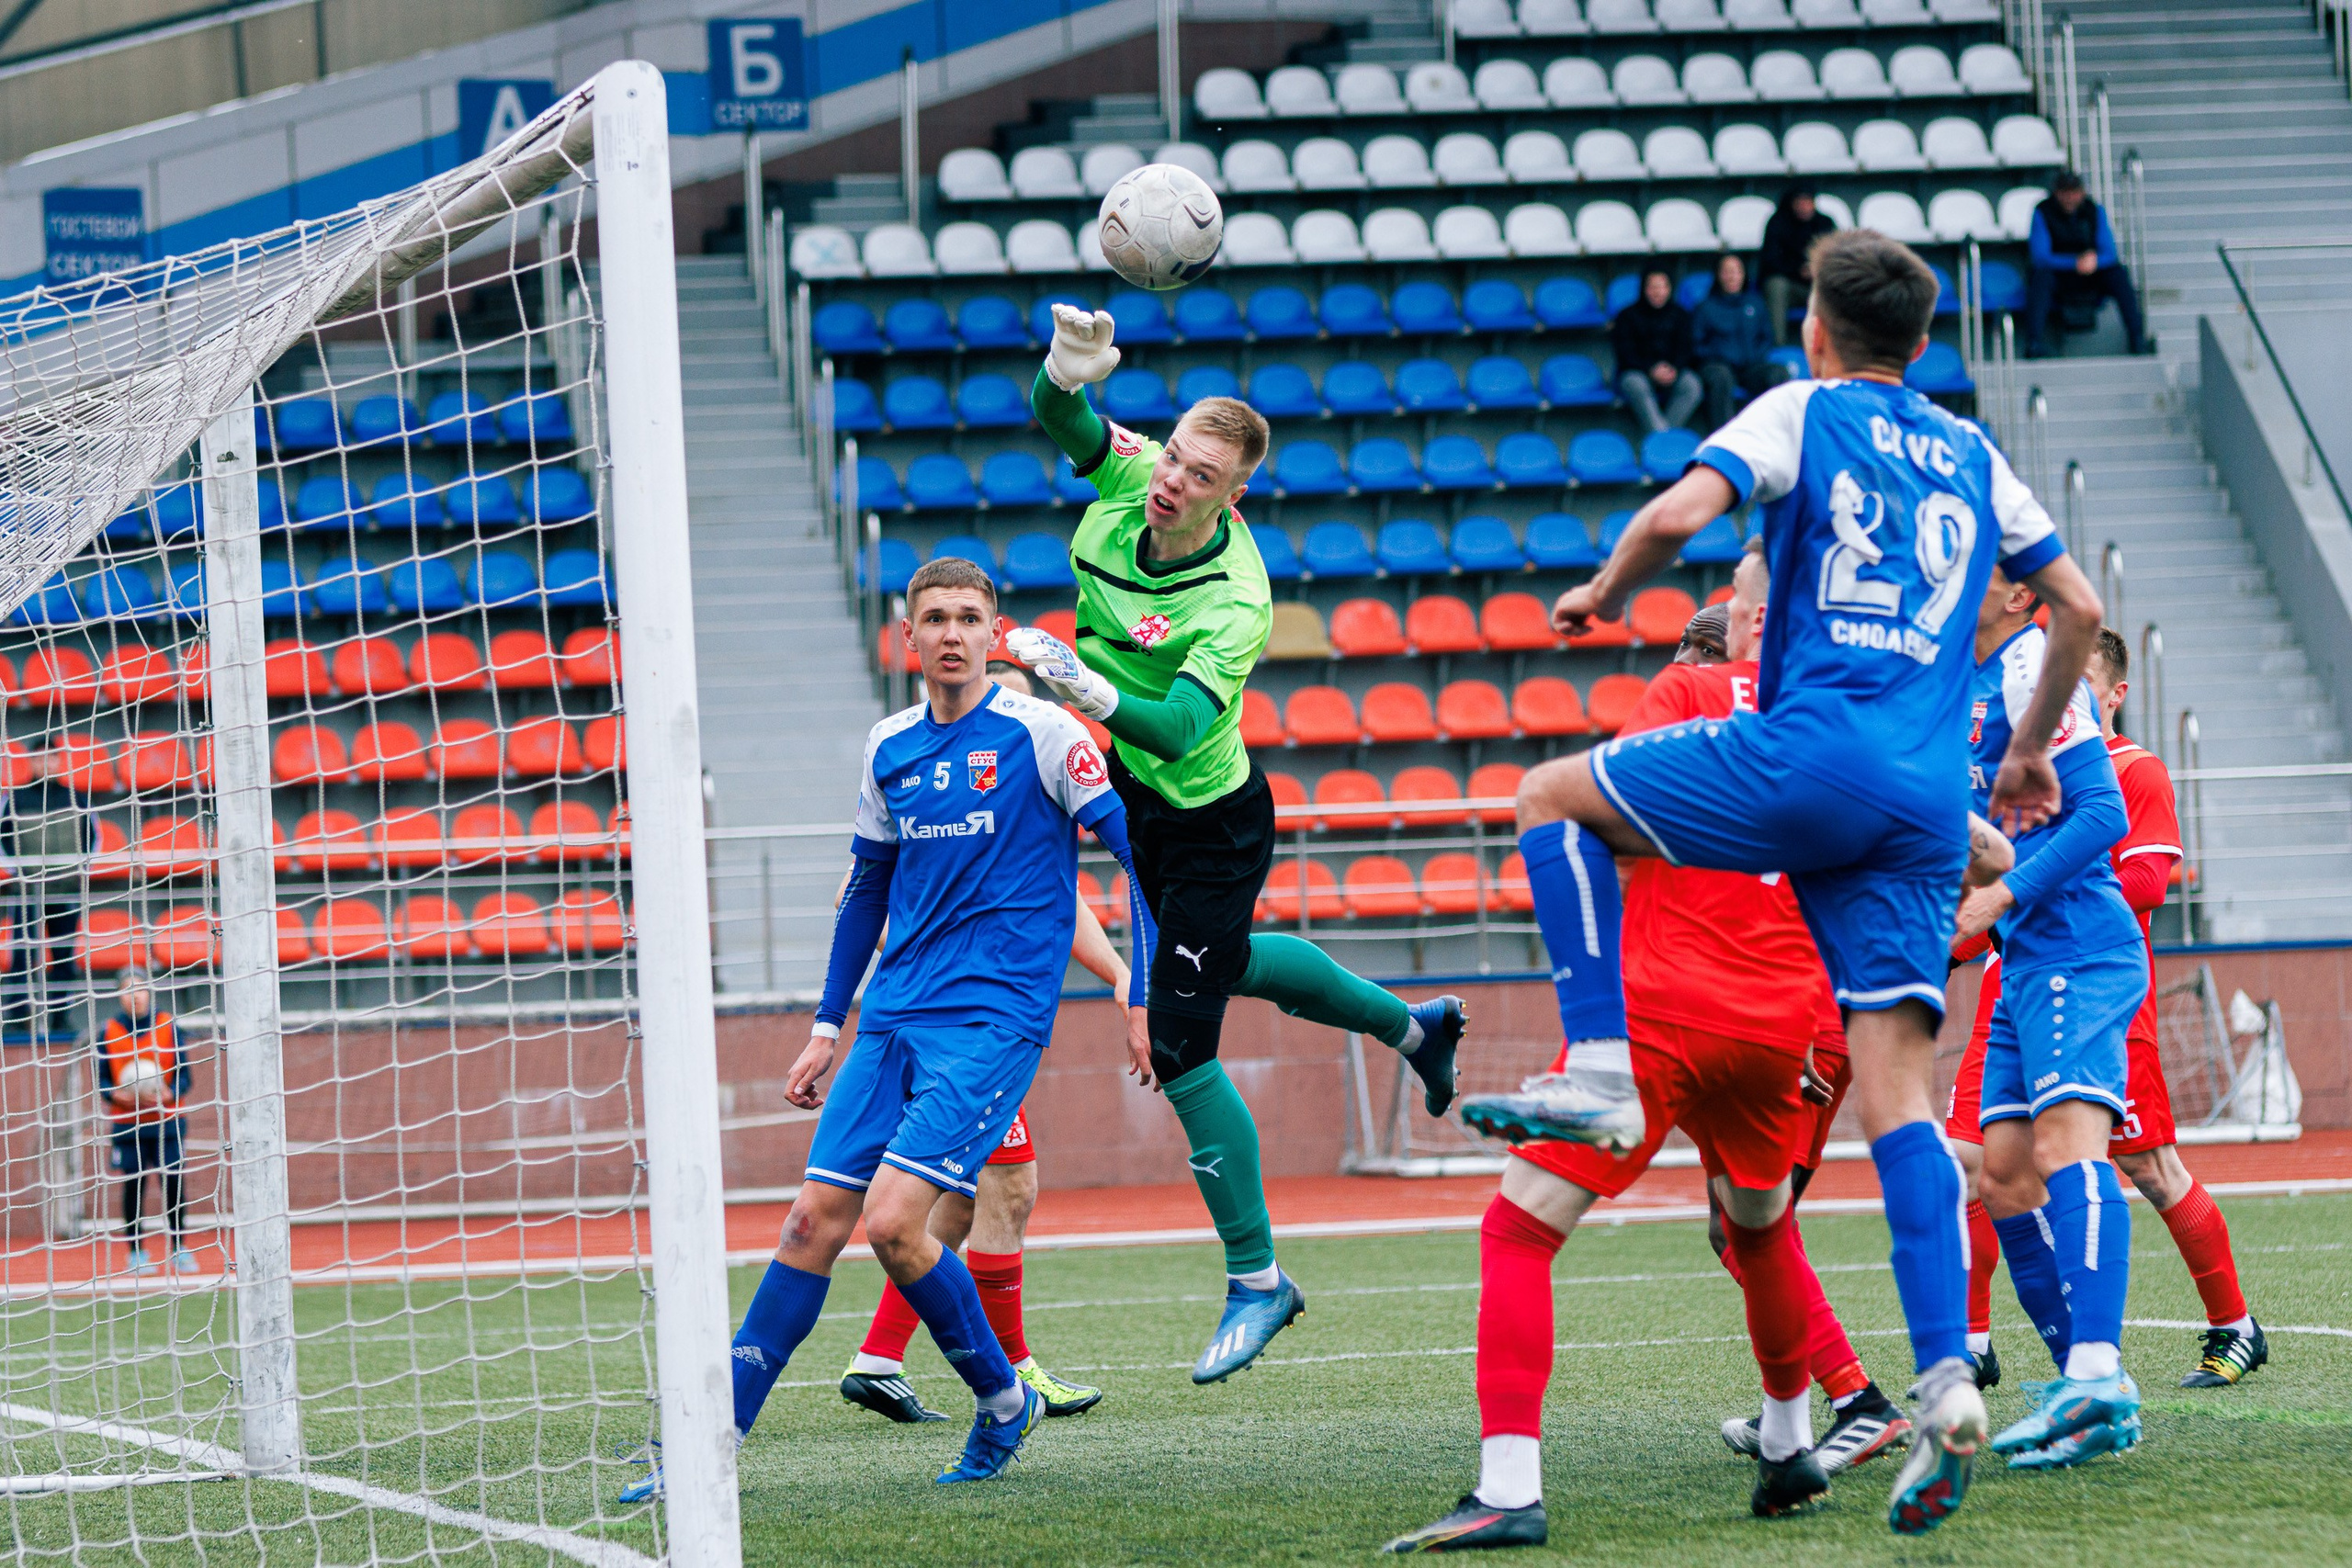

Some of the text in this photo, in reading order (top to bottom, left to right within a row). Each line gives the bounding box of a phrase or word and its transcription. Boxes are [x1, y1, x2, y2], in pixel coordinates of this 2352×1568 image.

[729, 24, 784, 98] Б
[481, 85, 530, 155] А
[714, 100, 802, 125] СЕКТОР
[50, 214, 139, 240] ГОСТЕВОЙ
[1817, 469, 1977, 636] 29
[901, 775, 921, 789] JAKO
[933, 761, 952, 790] 5
[941, 1157, 964, 1175] JAKO
